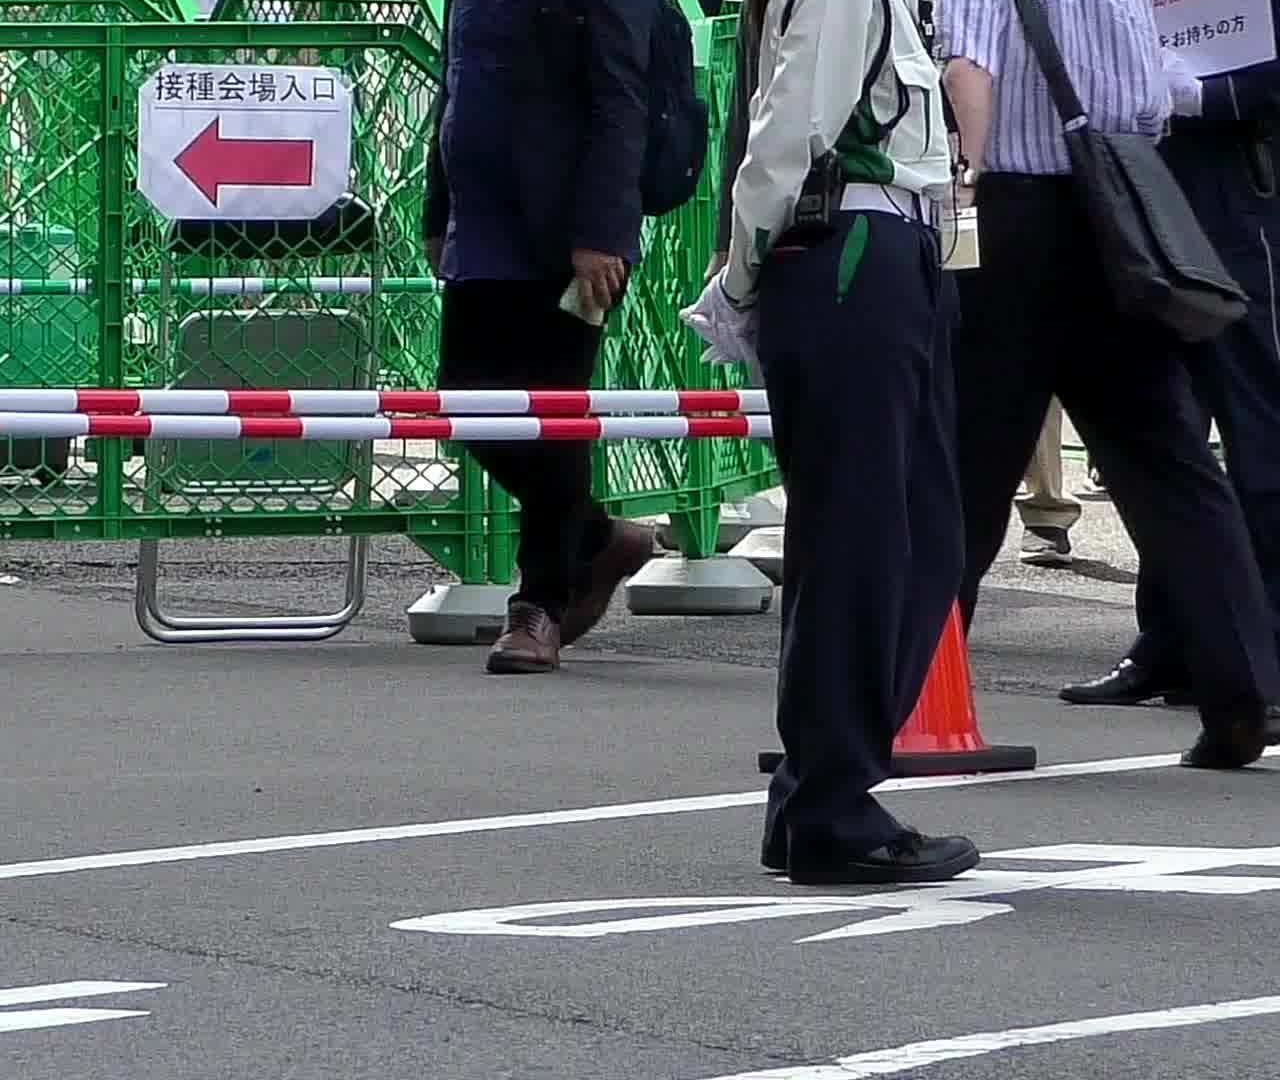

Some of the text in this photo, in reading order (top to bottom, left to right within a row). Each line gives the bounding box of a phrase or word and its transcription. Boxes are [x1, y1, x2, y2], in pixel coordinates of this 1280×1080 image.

[155, 71, 336, 102] 接種会場入口
